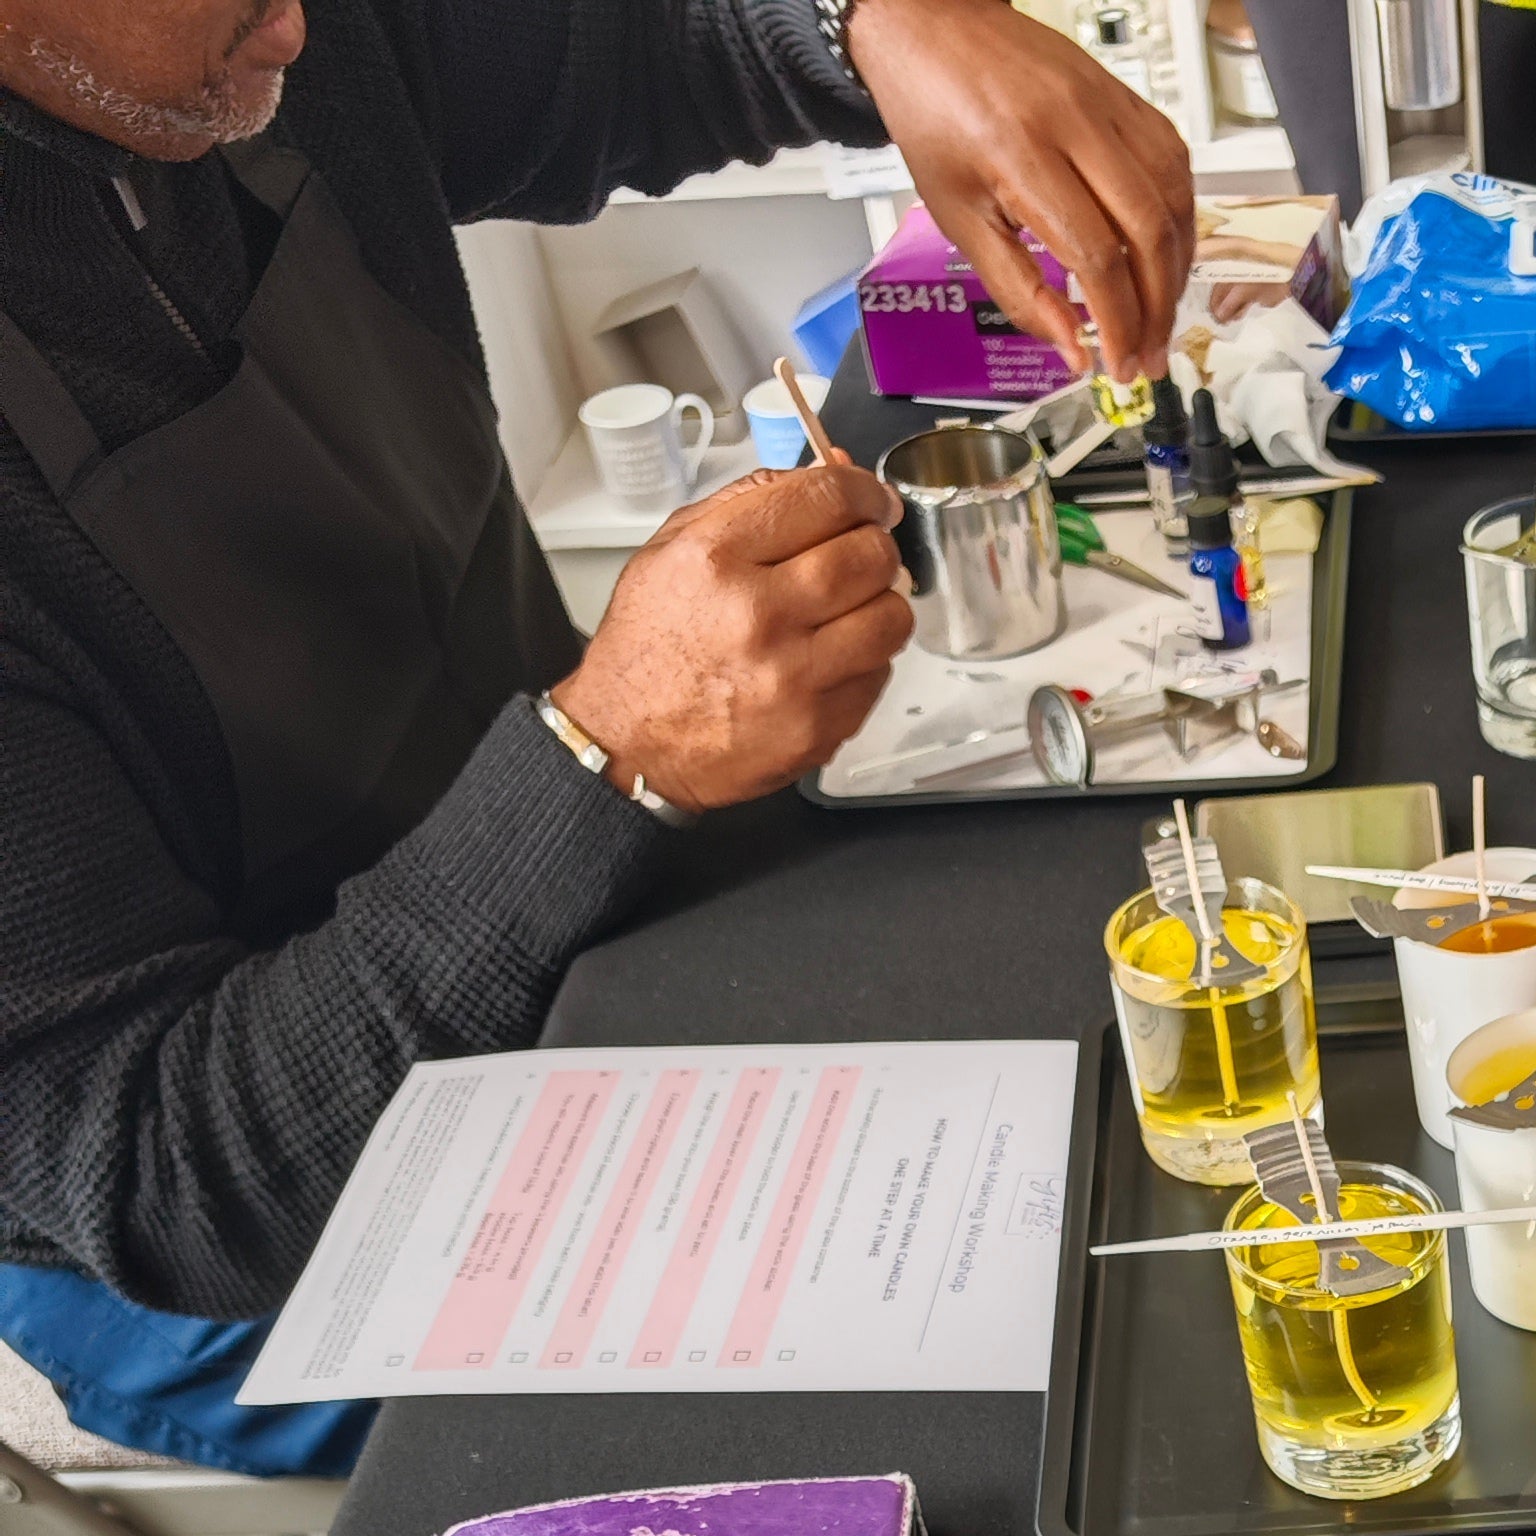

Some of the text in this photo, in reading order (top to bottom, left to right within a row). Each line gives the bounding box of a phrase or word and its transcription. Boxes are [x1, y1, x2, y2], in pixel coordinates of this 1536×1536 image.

[859, 284, 968, 313] 233413
[867, 1157, 910, 1258] ONE STEP AT A TIME
[881, 1117, 949, 1302] HOW TO MAKE YOUR OWN CANDLES
[946, 1123, 1014, 1294] Candle Making Workshop
